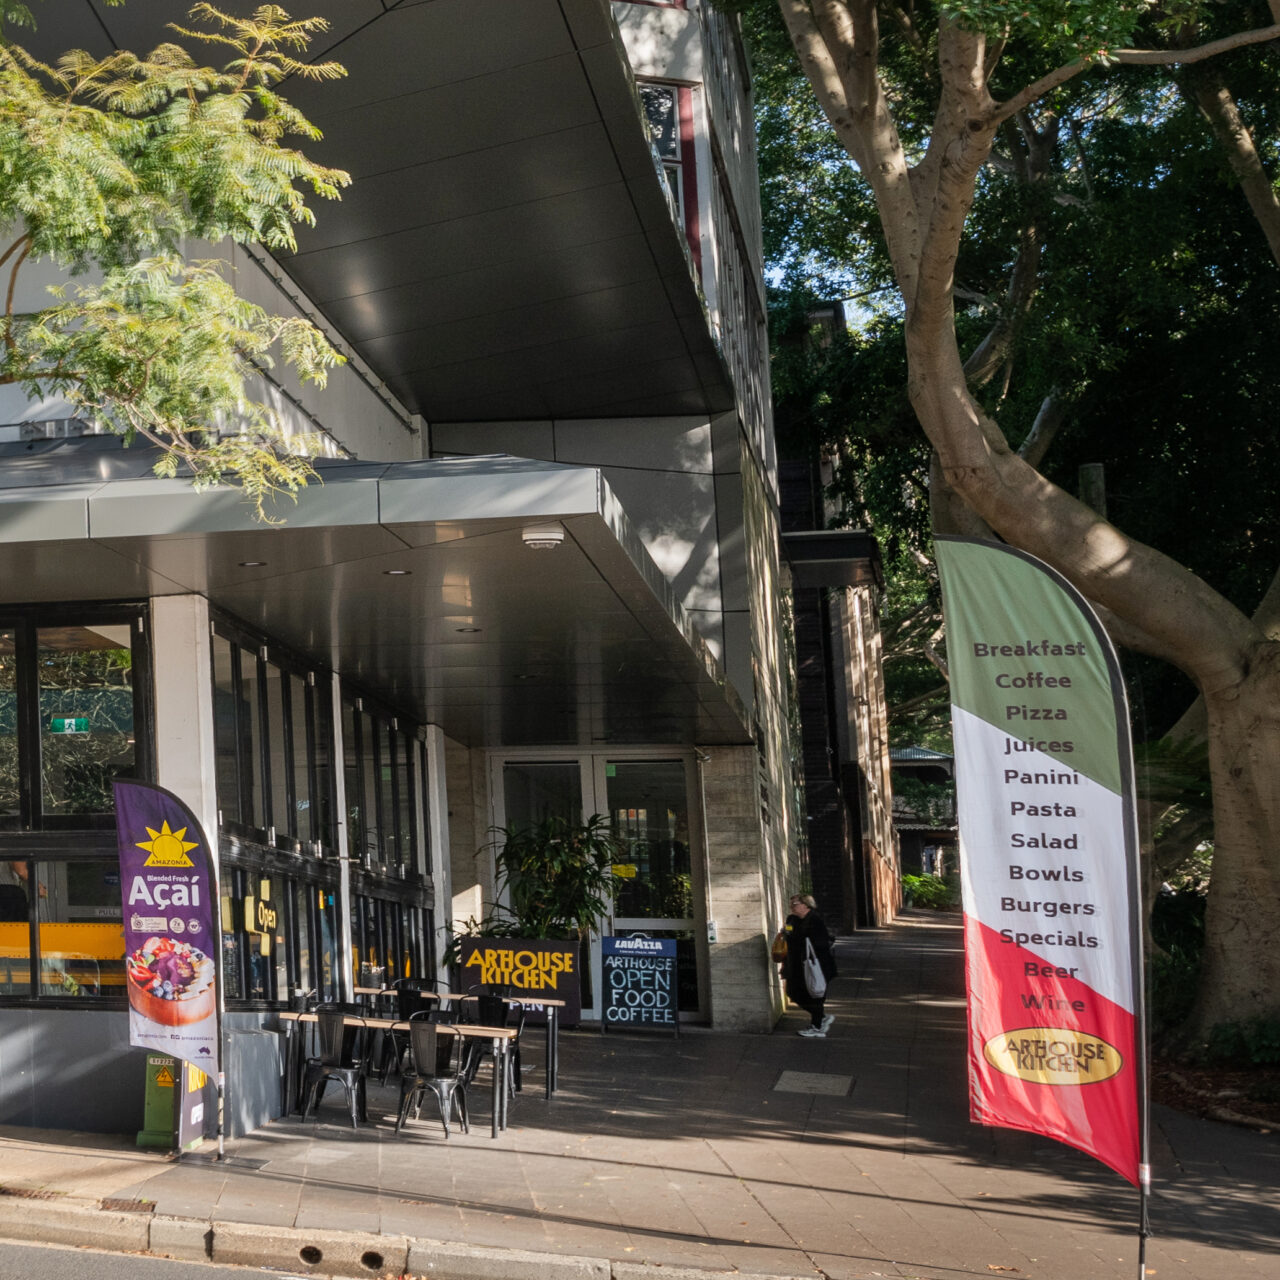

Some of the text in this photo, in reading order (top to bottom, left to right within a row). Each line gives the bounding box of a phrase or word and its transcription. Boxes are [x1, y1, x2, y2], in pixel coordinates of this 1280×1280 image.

[973, 640, 1086, 657] Breakfast
[995, 672, 1072, 689] Coffee
[1006, 705, 1068, 721] Pizza
[1004, 736, 1074, 755] Juices
[1004, 769, 1079, 785] Panini
[1011, 801, 1077, 817] Pasta
[1011, 832, 1078, 850] Salad
[1009, 865, 1084, 882] Bowls
[128, 875, 200, 910] Açaí
[1001, 897, 1095, 917] Burgers
[258, 901, 277, 933] Open
[614, 938, 663, 950] LAVAZZA
[1000, 929, 1099, 949] Specials
[465, 948, 573, 972] ARTHOUSE
[604, 956, 672, 970] ARTHOUSE
[481, 967, 557, 990] KITCHEN
[610, 969, 670, 990] OPEN
[1024, 962, 1079, 979] Beer
[612, 989, 670, 1008] FOOD
[1021, 994, 1085, 1012] Wine
[606, 1006, 676, 1023] COFFEE
[1002, 1038, 1105, 1060] ARTHOUSE
[1017, 1052, 1090, 1073] KITCHEN
